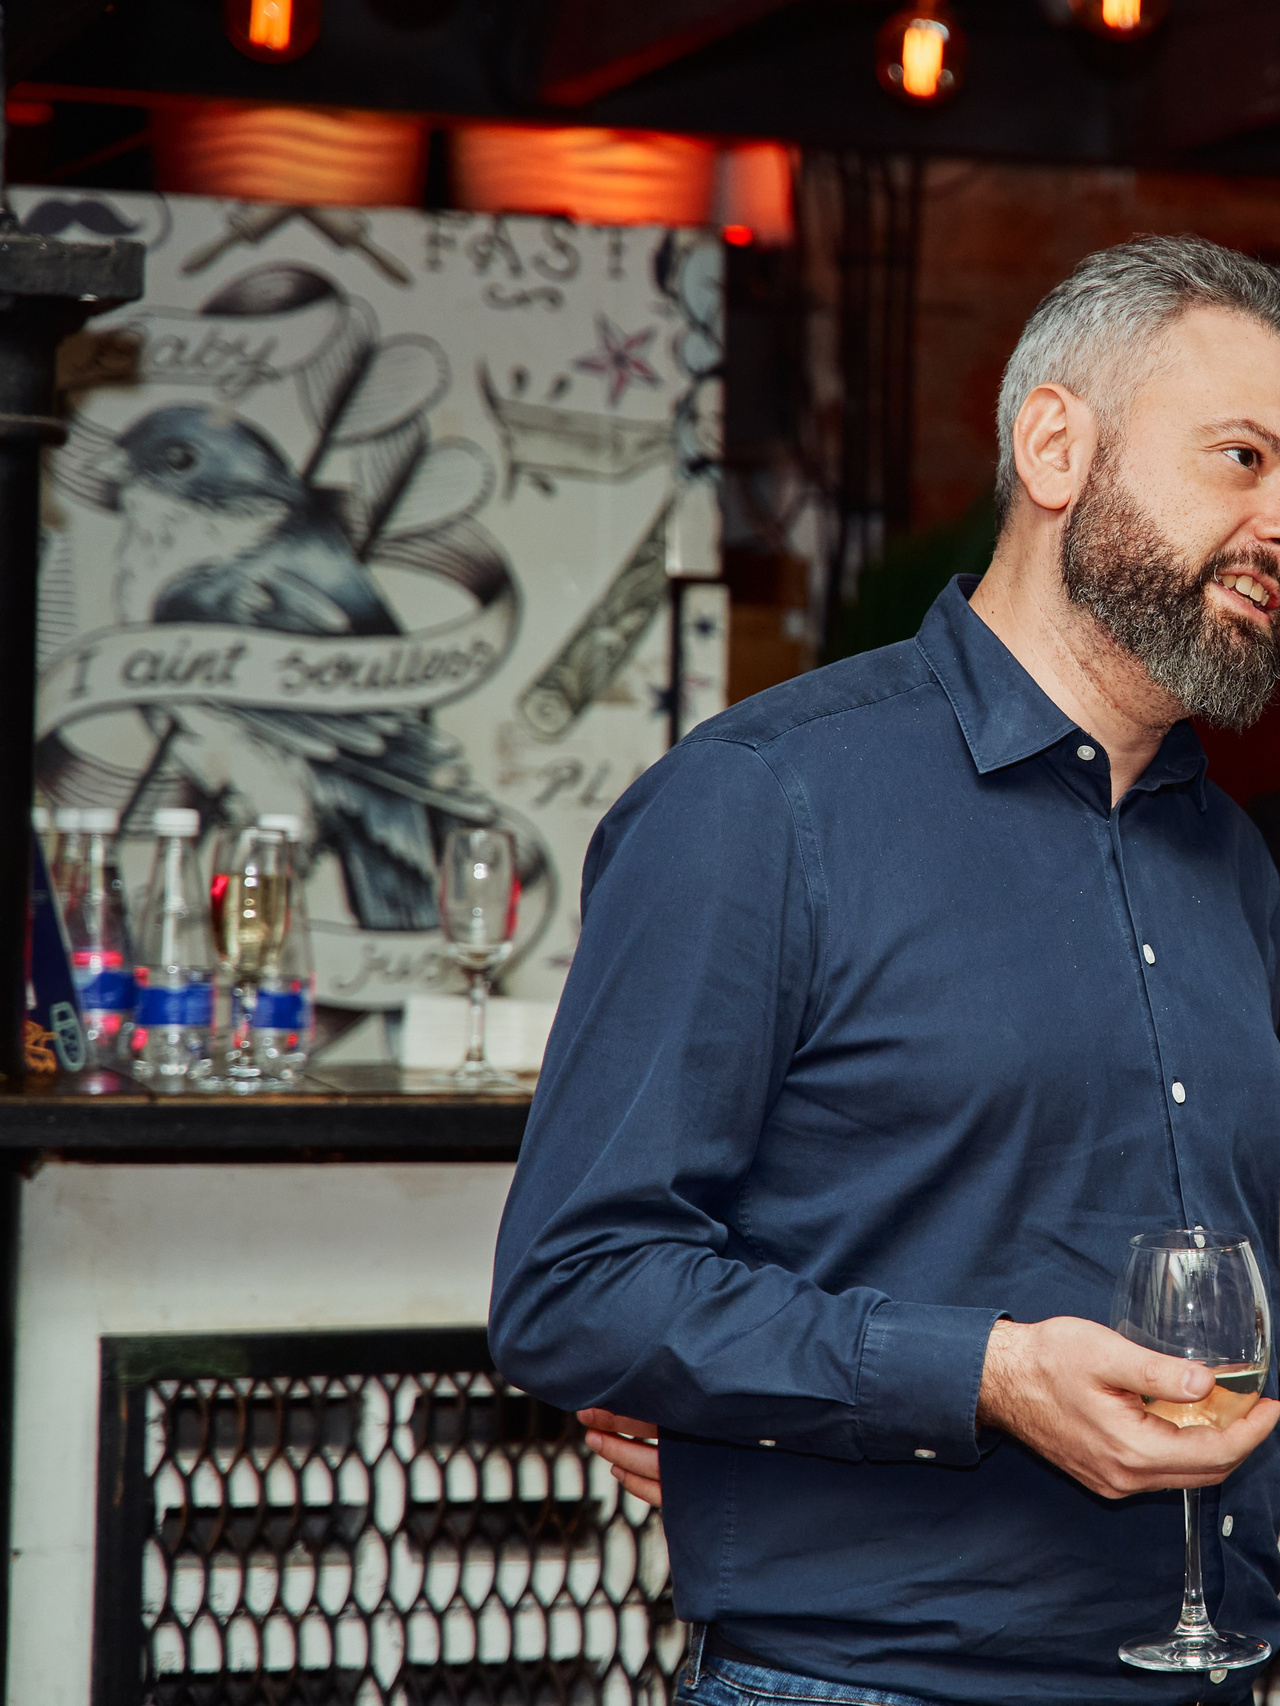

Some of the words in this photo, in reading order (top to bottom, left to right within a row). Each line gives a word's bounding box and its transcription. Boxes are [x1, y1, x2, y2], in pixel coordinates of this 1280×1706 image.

[69, 645, 101, 700] I
[119, 636, 252, 688] aint
[276, 639, 494, 697] soulless
